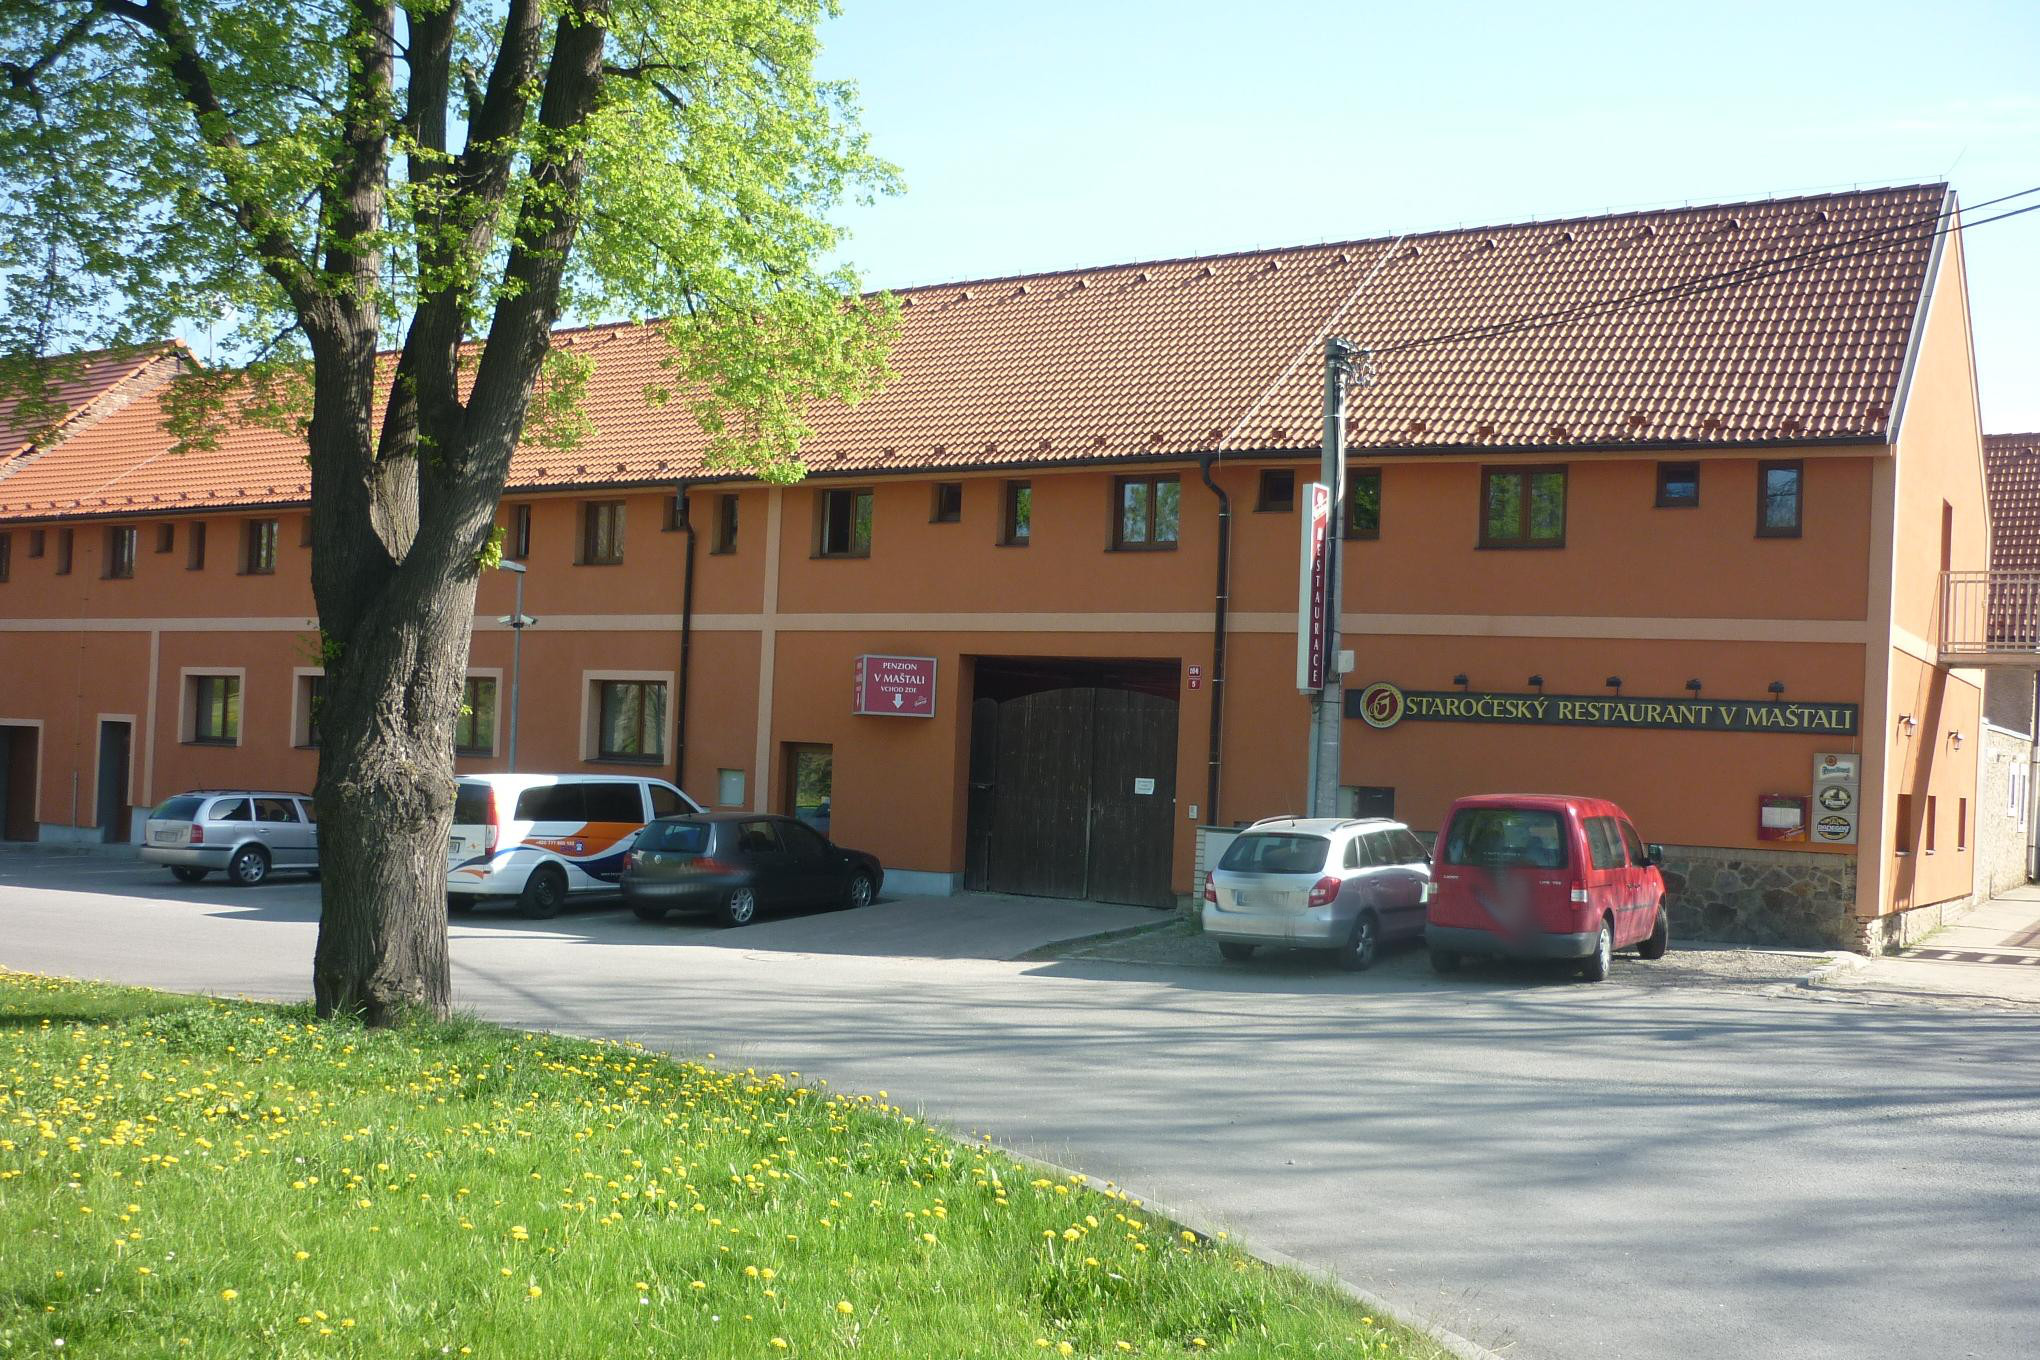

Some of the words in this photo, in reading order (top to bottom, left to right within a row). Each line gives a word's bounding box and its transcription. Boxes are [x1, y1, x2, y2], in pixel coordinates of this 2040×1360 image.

[1312, 527, 1324, 682] ESTAURACE
[882, 662, 918, 670] PENZION
[873, 673, 882, 682] V
[883, 672, 925, 685] MAŠTALI
[1406, 695, 1549, 719] STAROČESKÝ
[1558, 701, 1712, 724] RESTAURANT
[1718, 706, 1736, 725] V
[1745, 704, 1853, 729] MAŠTALI
